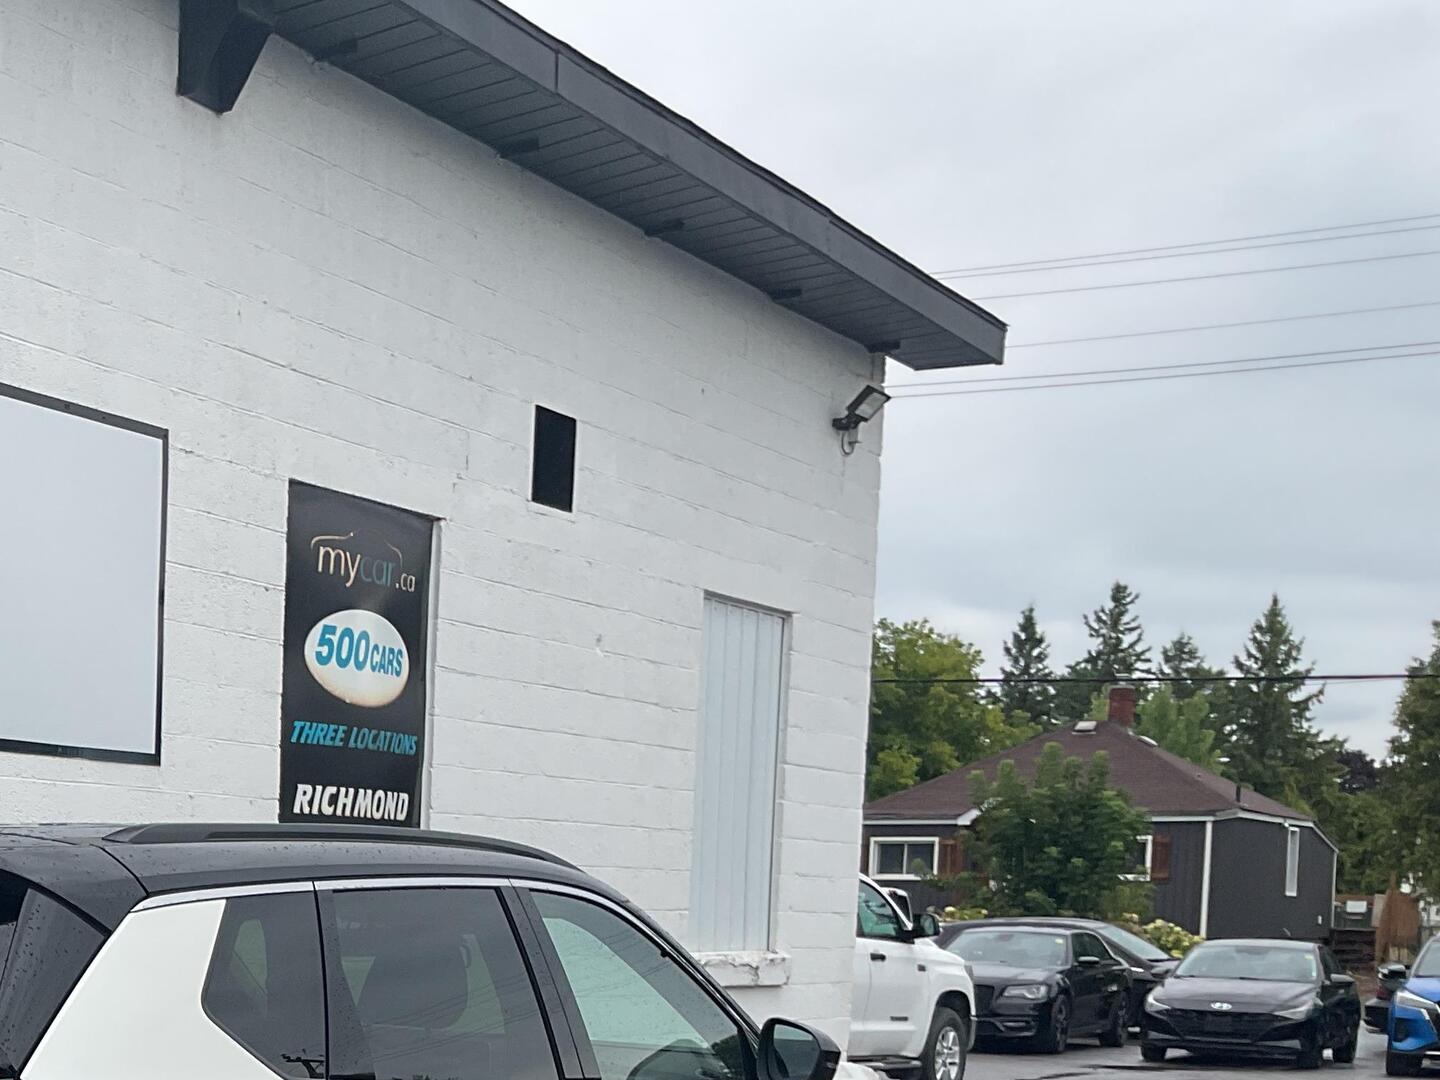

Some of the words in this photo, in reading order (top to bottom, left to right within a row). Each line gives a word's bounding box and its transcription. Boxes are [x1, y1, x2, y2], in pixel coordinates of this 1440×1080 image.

[290, 720, 348, 747] THREE
[348, 726, 418, 755] LOCATIONS
[292, 783, 409, 821] RICHMOND
